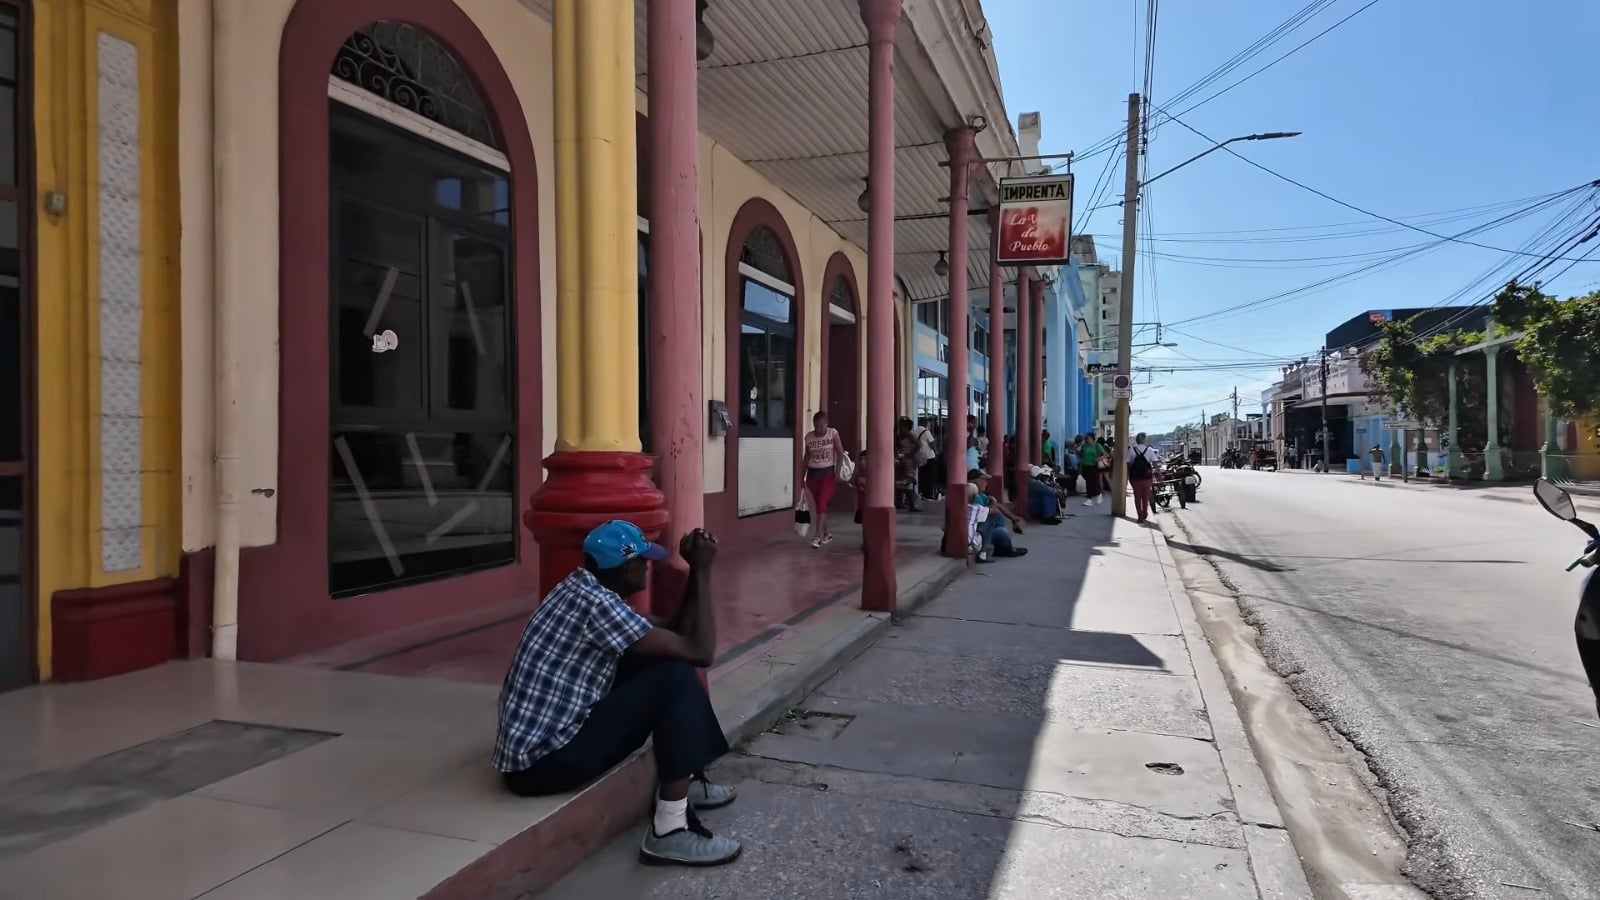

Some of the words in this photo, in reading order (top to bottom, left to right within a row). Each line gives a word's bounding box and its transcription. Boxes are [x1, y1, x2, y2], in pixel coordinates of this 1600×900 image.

[1003, 184, 1065, 200] IMPRENTA
[1008, 213, 1026, 226] La
[1008, 240, 1049, 252] Pueblo
